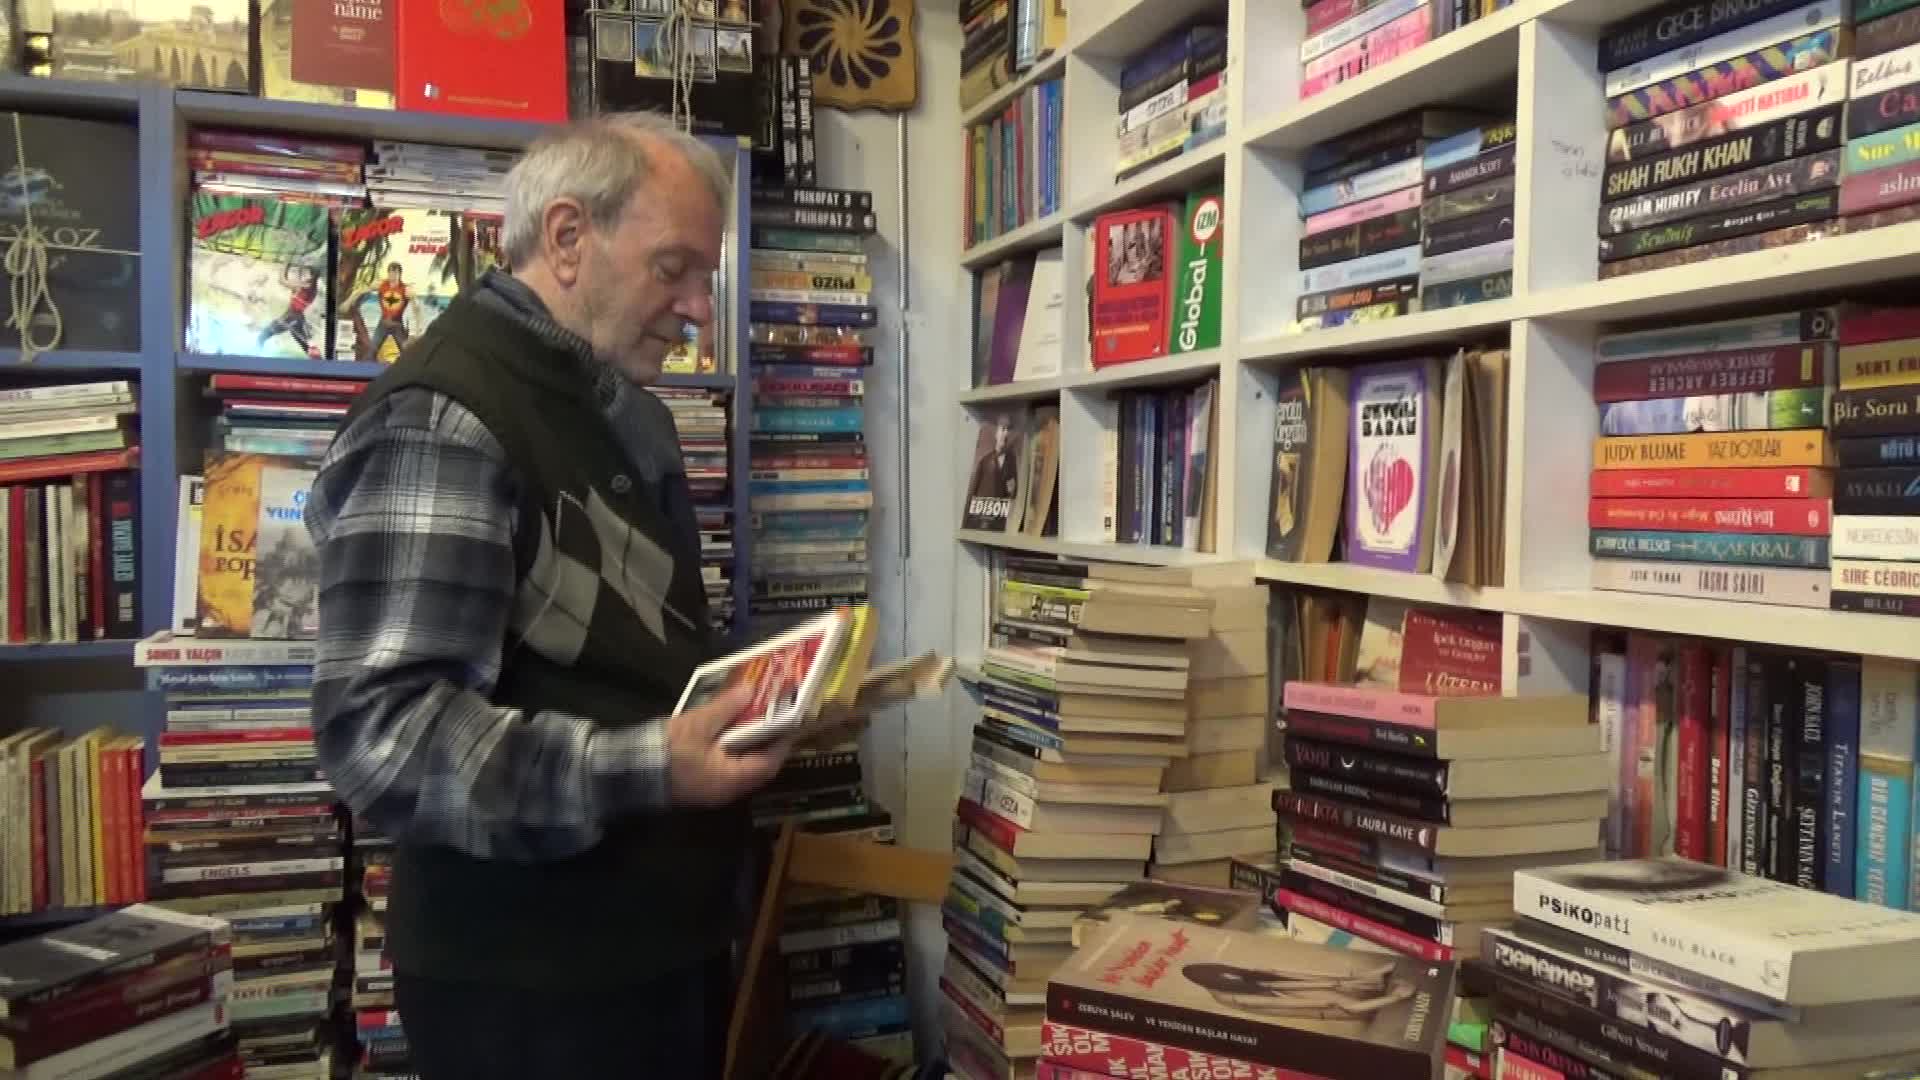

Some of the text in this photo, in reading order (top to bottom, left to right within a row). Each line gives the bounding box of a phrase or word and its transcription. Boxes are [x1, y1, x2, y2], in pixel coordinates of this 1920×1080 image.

[1607, 166, 1650, 195] SHAH
[1653, 150, 1699, 184] RUKH
[1702, 136, 1753, 172] KHAN
[1608, 200, 1652, 226] GRAHAM
[1178, 257, 1208, 352] Global
[1865, 401, 1908, 417] Soru
[1603, 440, 1638, 462] JUDY
[1640, 442, 1687, 461] BLUME
[1356, 815, 1388, 833] LAURA
[1389, 823, 1414, 841] KAYE
